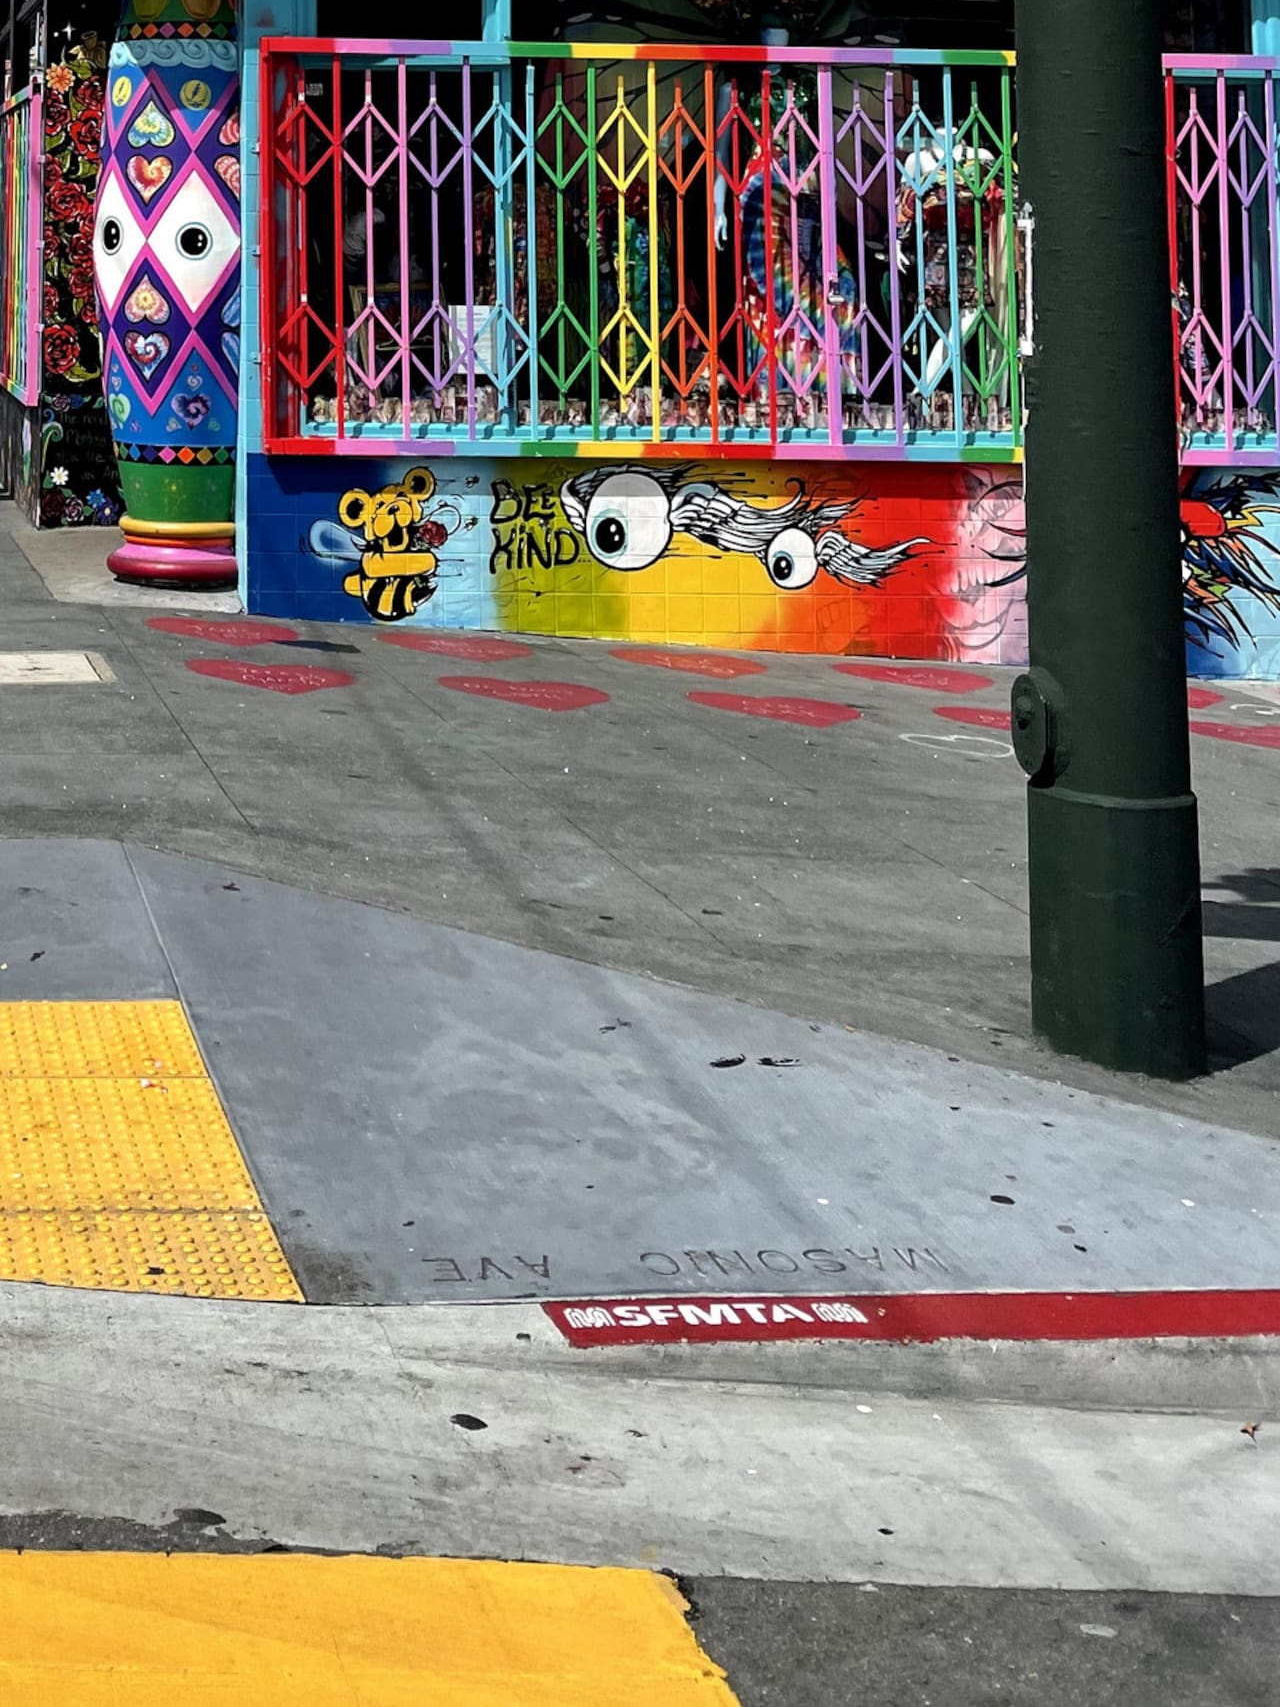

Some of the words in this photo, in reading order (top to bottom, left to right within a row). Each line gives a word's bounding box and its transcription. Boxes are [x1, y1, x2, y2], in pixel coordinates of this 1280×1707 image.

[489, 478, 556, 525] BEE
[422, 1254, 552, 1284] AVE
[639, 1247, 949, 1279] MASONIC
[613, 1303, 814, 1327] SFMTA
